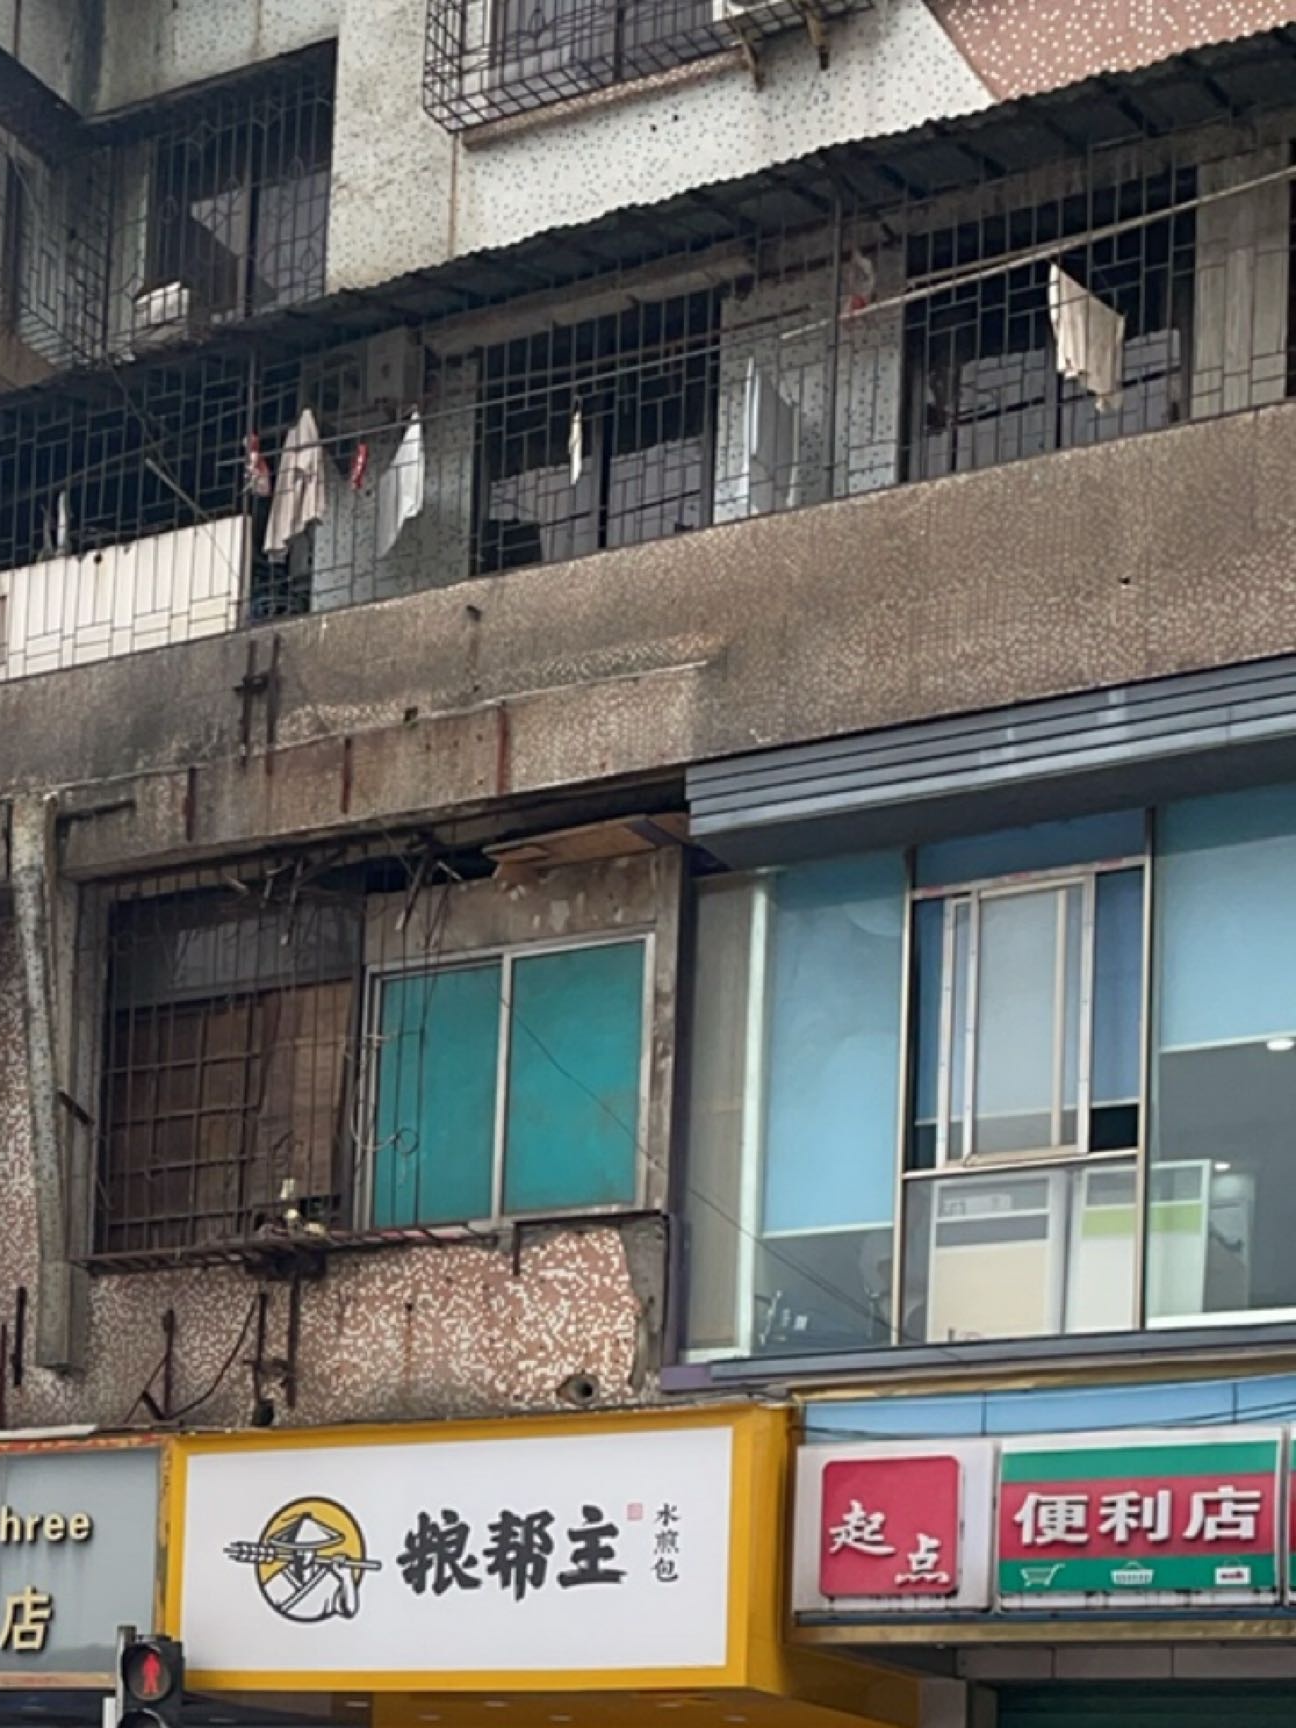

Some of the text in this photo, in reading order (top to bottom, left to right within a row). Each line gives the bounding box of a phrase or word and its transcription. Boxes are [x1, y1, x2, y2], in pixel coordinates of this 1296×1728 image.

[651, 1502, 680, 1583] 水煎包
[828, 1499, 950, 1585] 起点
[1014, 1485, 1262, 1546] 便利店
